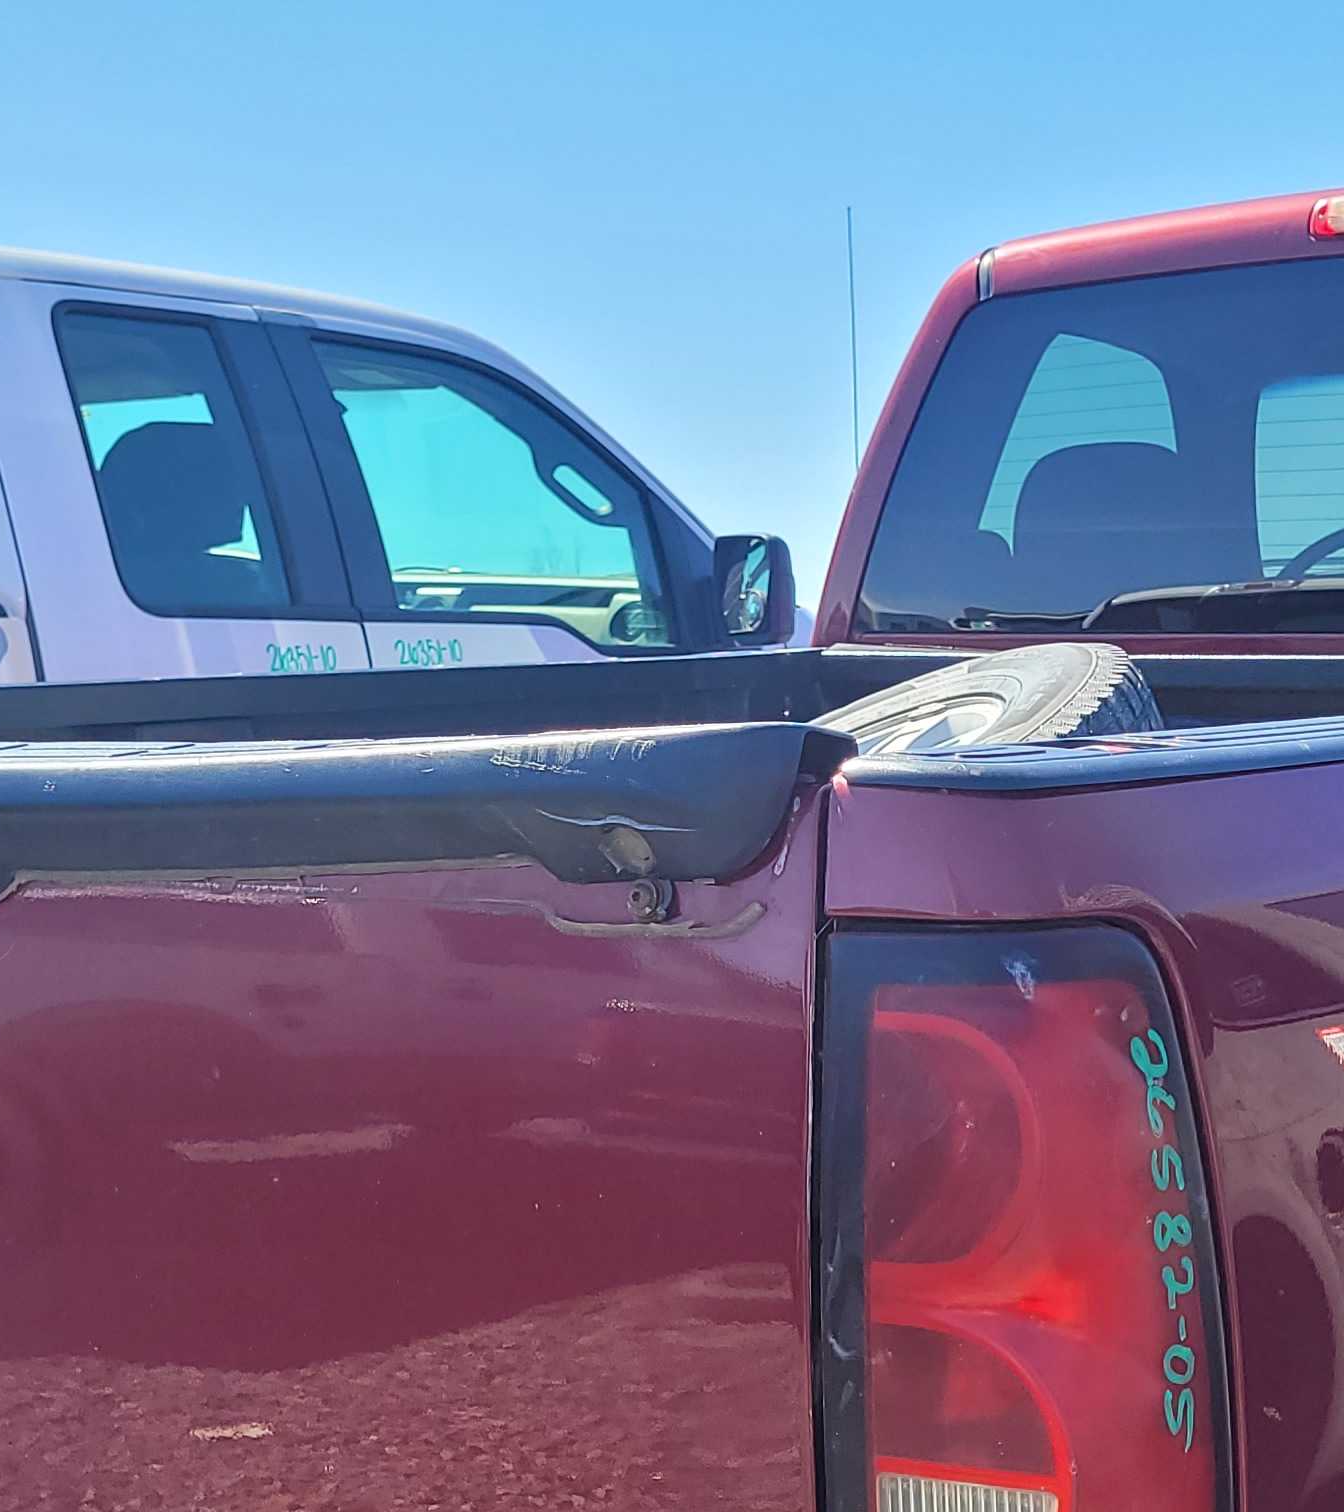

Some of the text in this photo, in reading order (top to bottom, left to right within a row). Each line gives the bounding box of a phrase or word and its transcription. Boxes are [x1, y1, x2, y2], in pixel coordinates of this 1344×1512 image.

[266, 642, 337, 673] 26351-10
[394, 639, 463, 667] 26351-10
[1129, 1028, 1197, 1453] 26582-05
